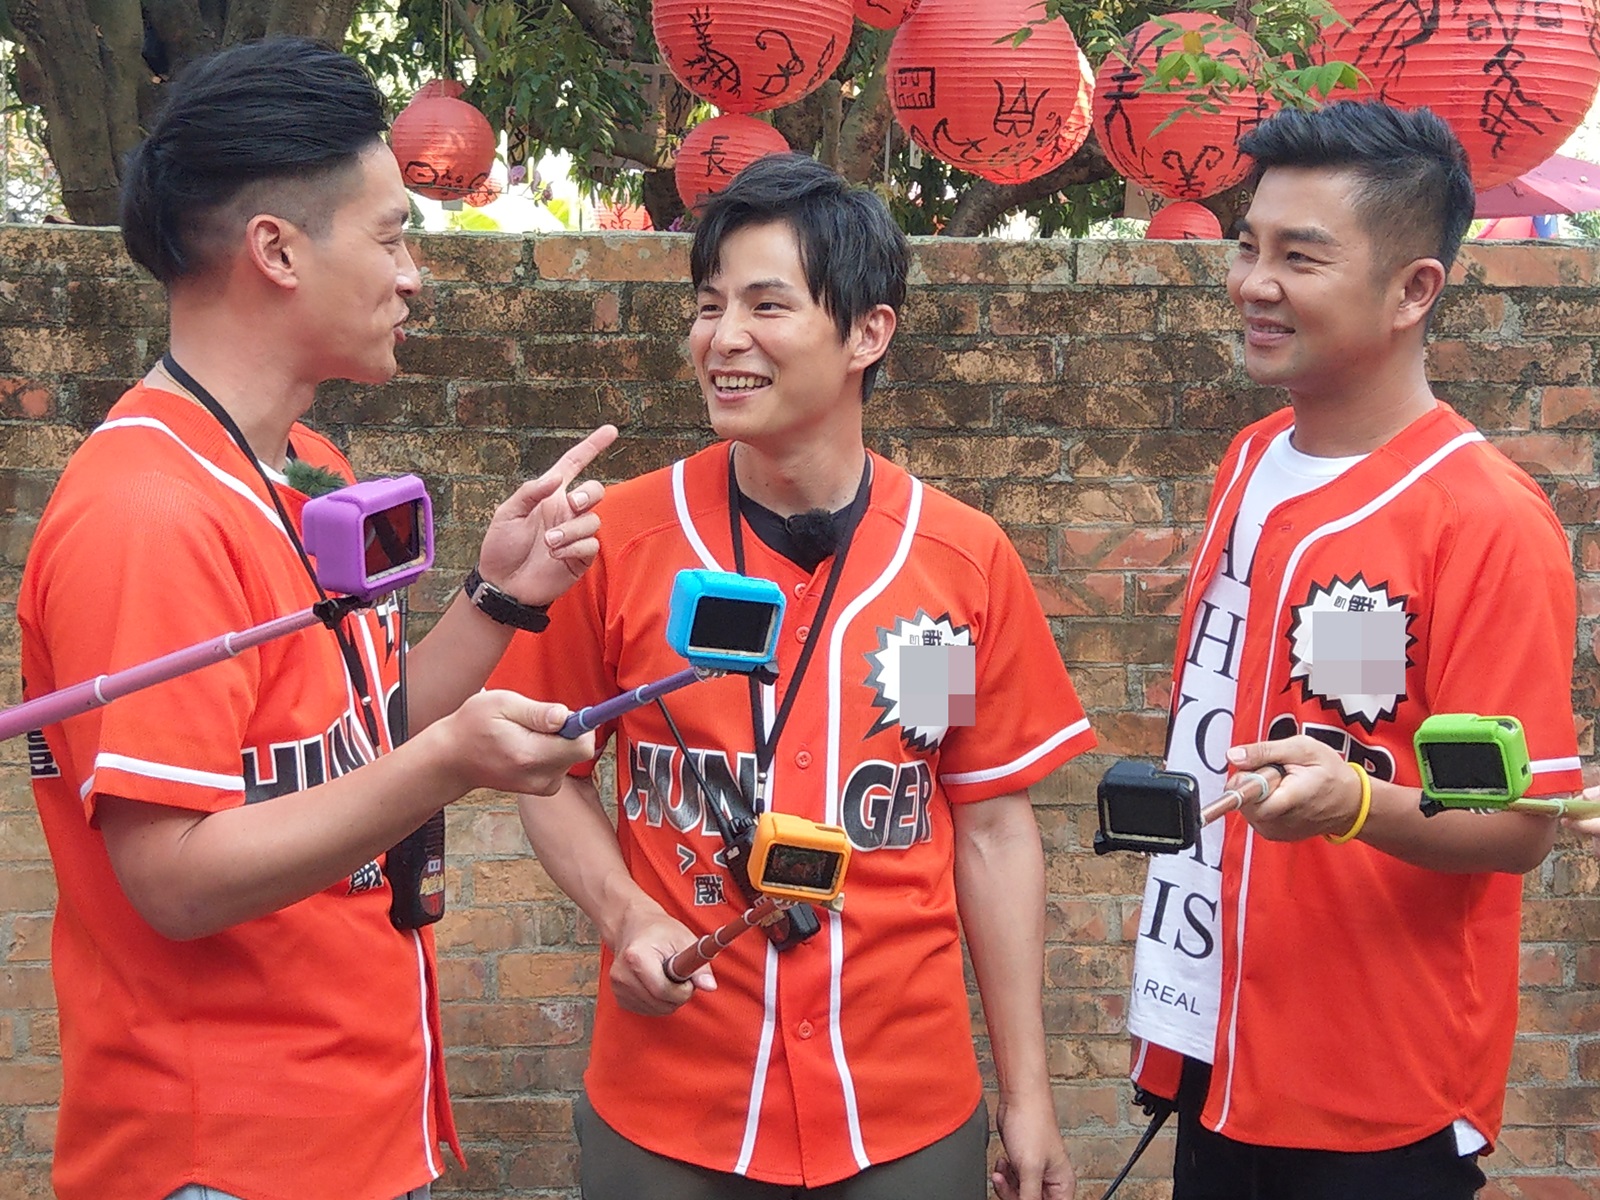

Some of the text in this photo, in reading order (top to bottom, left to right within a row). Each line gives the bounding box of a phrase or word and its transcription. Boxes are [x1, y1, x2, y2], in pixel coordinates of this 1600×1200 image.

[623, 739, 935, 852] HUN GER
[1140, 876, 1218, 960] IS
